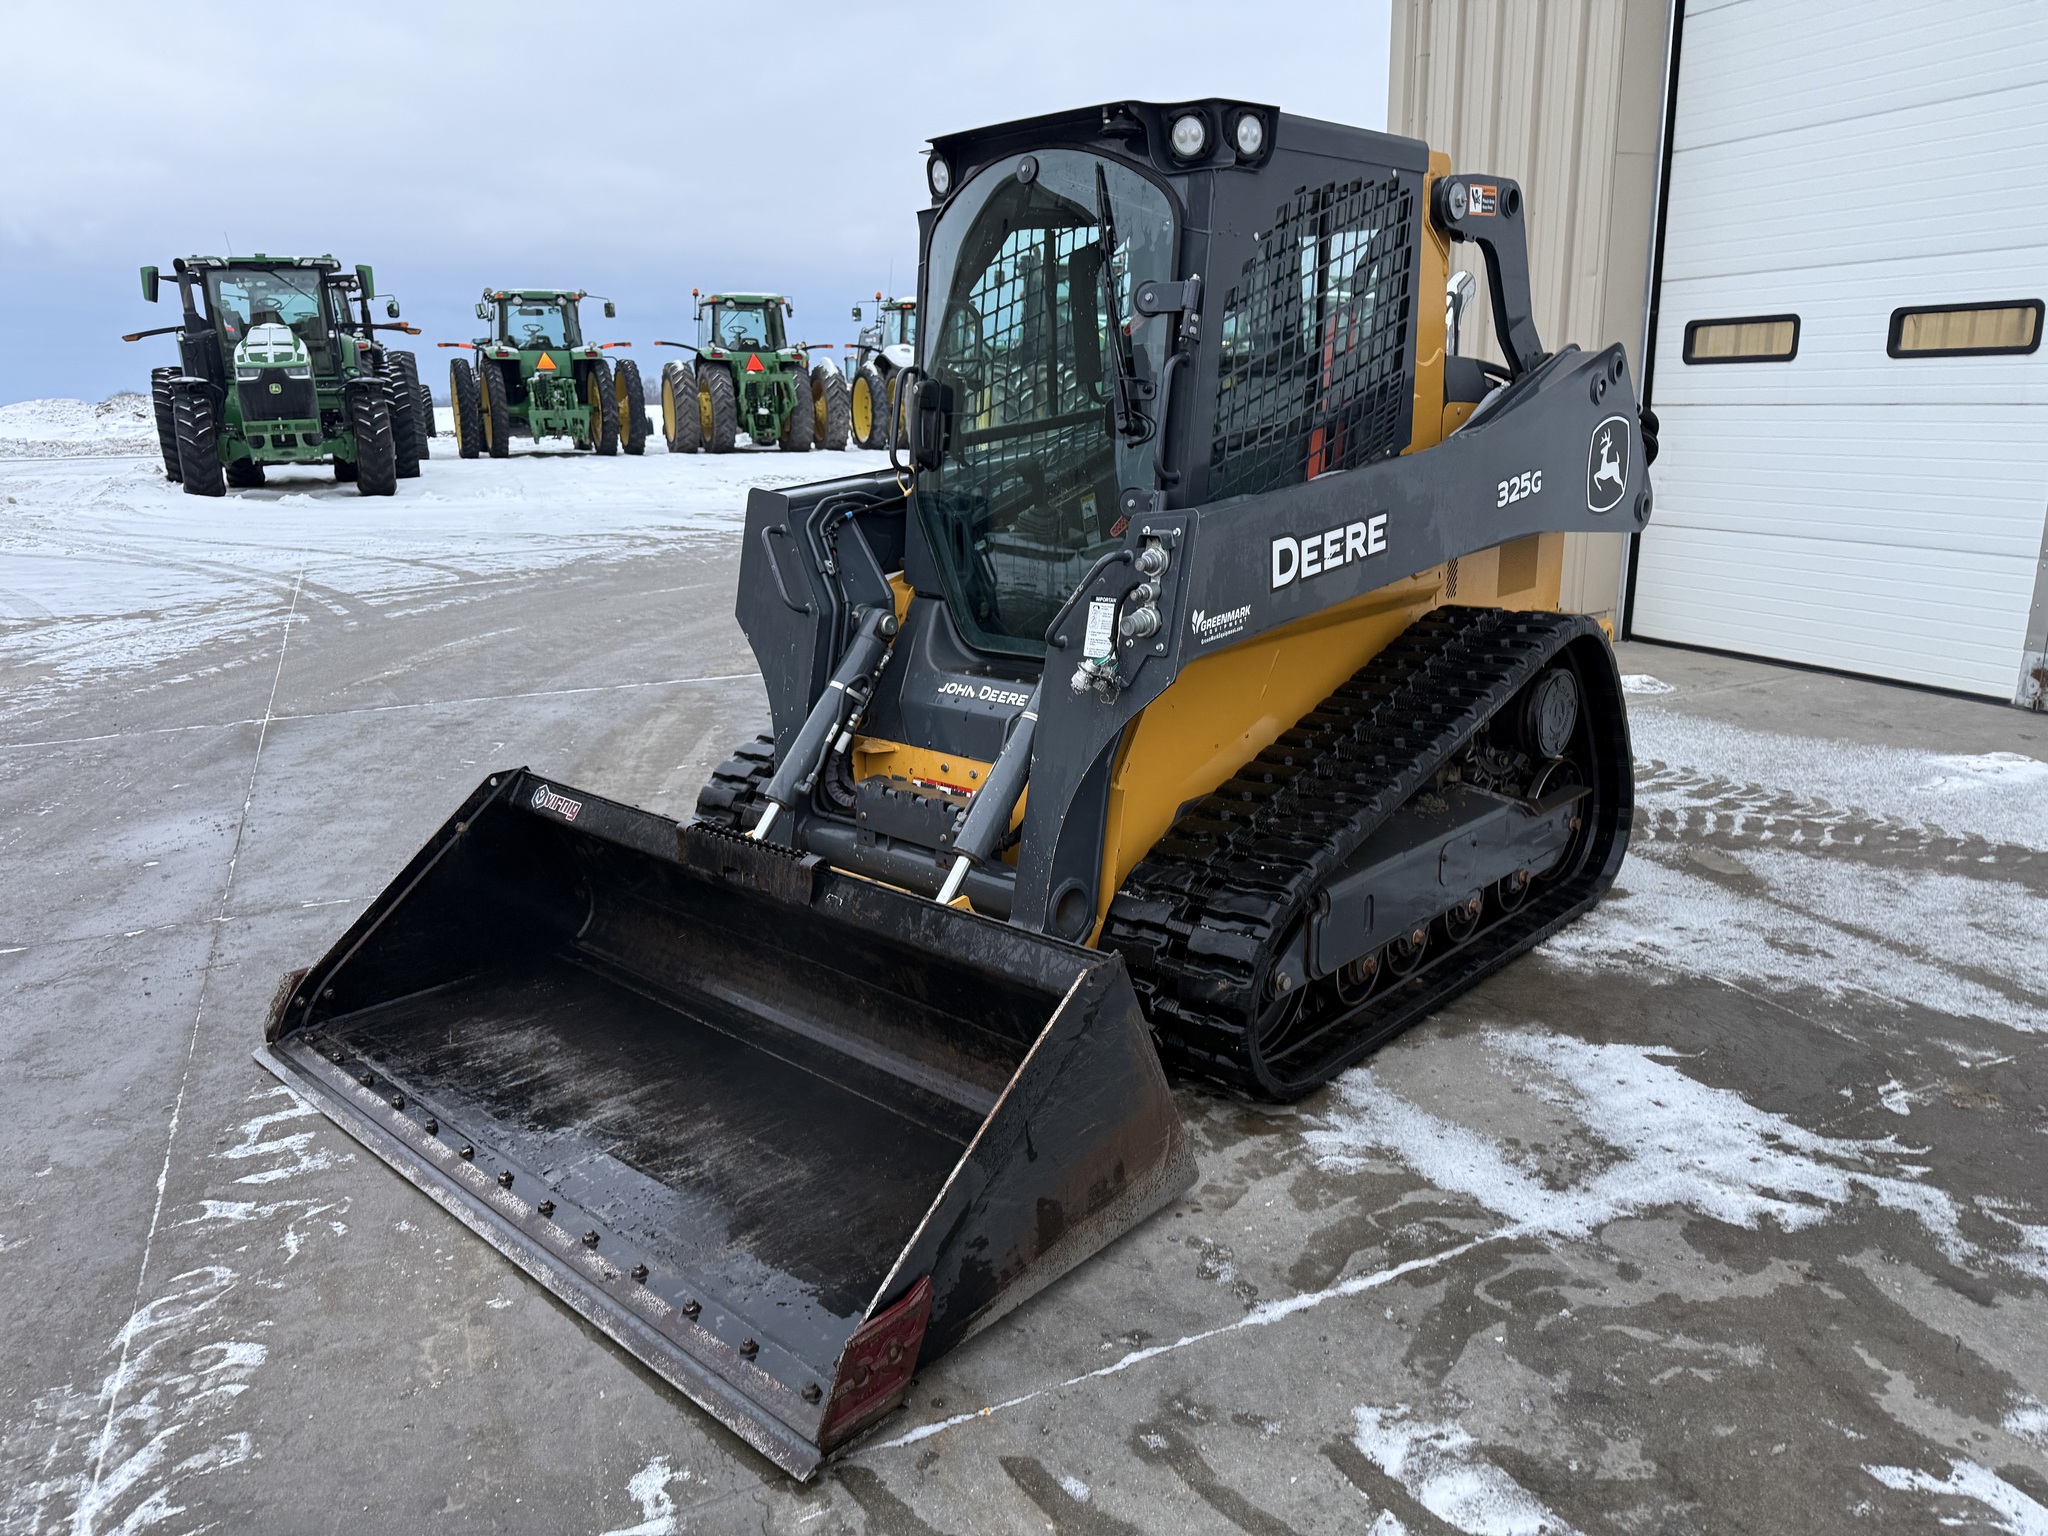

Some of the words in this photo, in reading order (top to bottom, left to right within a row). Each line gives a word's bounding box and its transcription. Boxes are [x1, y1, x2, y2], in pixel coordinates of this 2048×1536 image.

[1497, 470, 1542, 508] 325G
[1272, 513, 1387, 590] DEERE
[1200, 604, 1251, 632] GREENMARK
[1204, 616, 1247, 637] EQUIPMENT
[937, 682, 976, 698] JOHN
[979, 685, 1029, 706] DEERE
